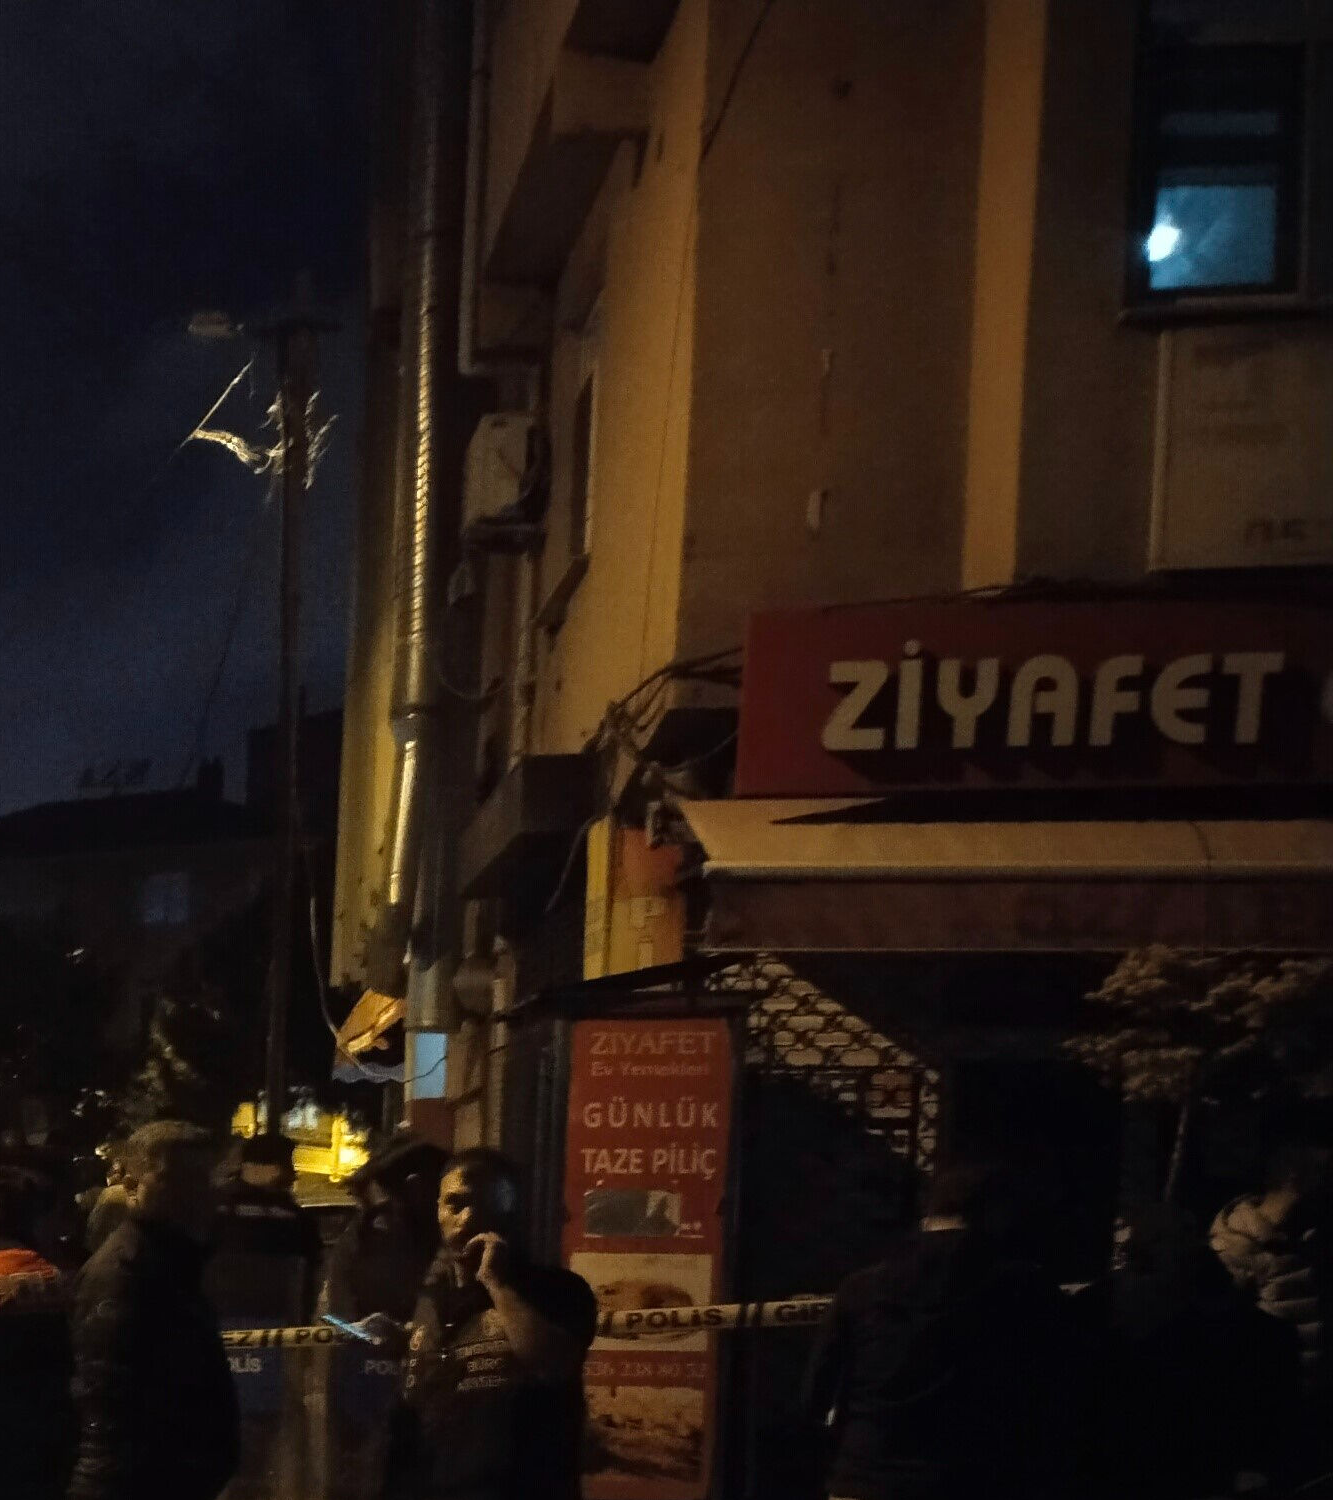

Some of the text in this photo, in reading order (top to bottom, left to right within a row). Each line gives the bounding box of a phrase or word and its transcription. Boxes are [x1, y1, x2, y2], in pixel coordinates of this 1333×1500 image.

[820, 639, 1286, 751] ZİYAFET
[583, 1096, 720, 1129] GÜNLÜK
[582, 1142, 718, 1182] TAZE PİLİÇ
[626, 1308, 724, 1329] POLİS
